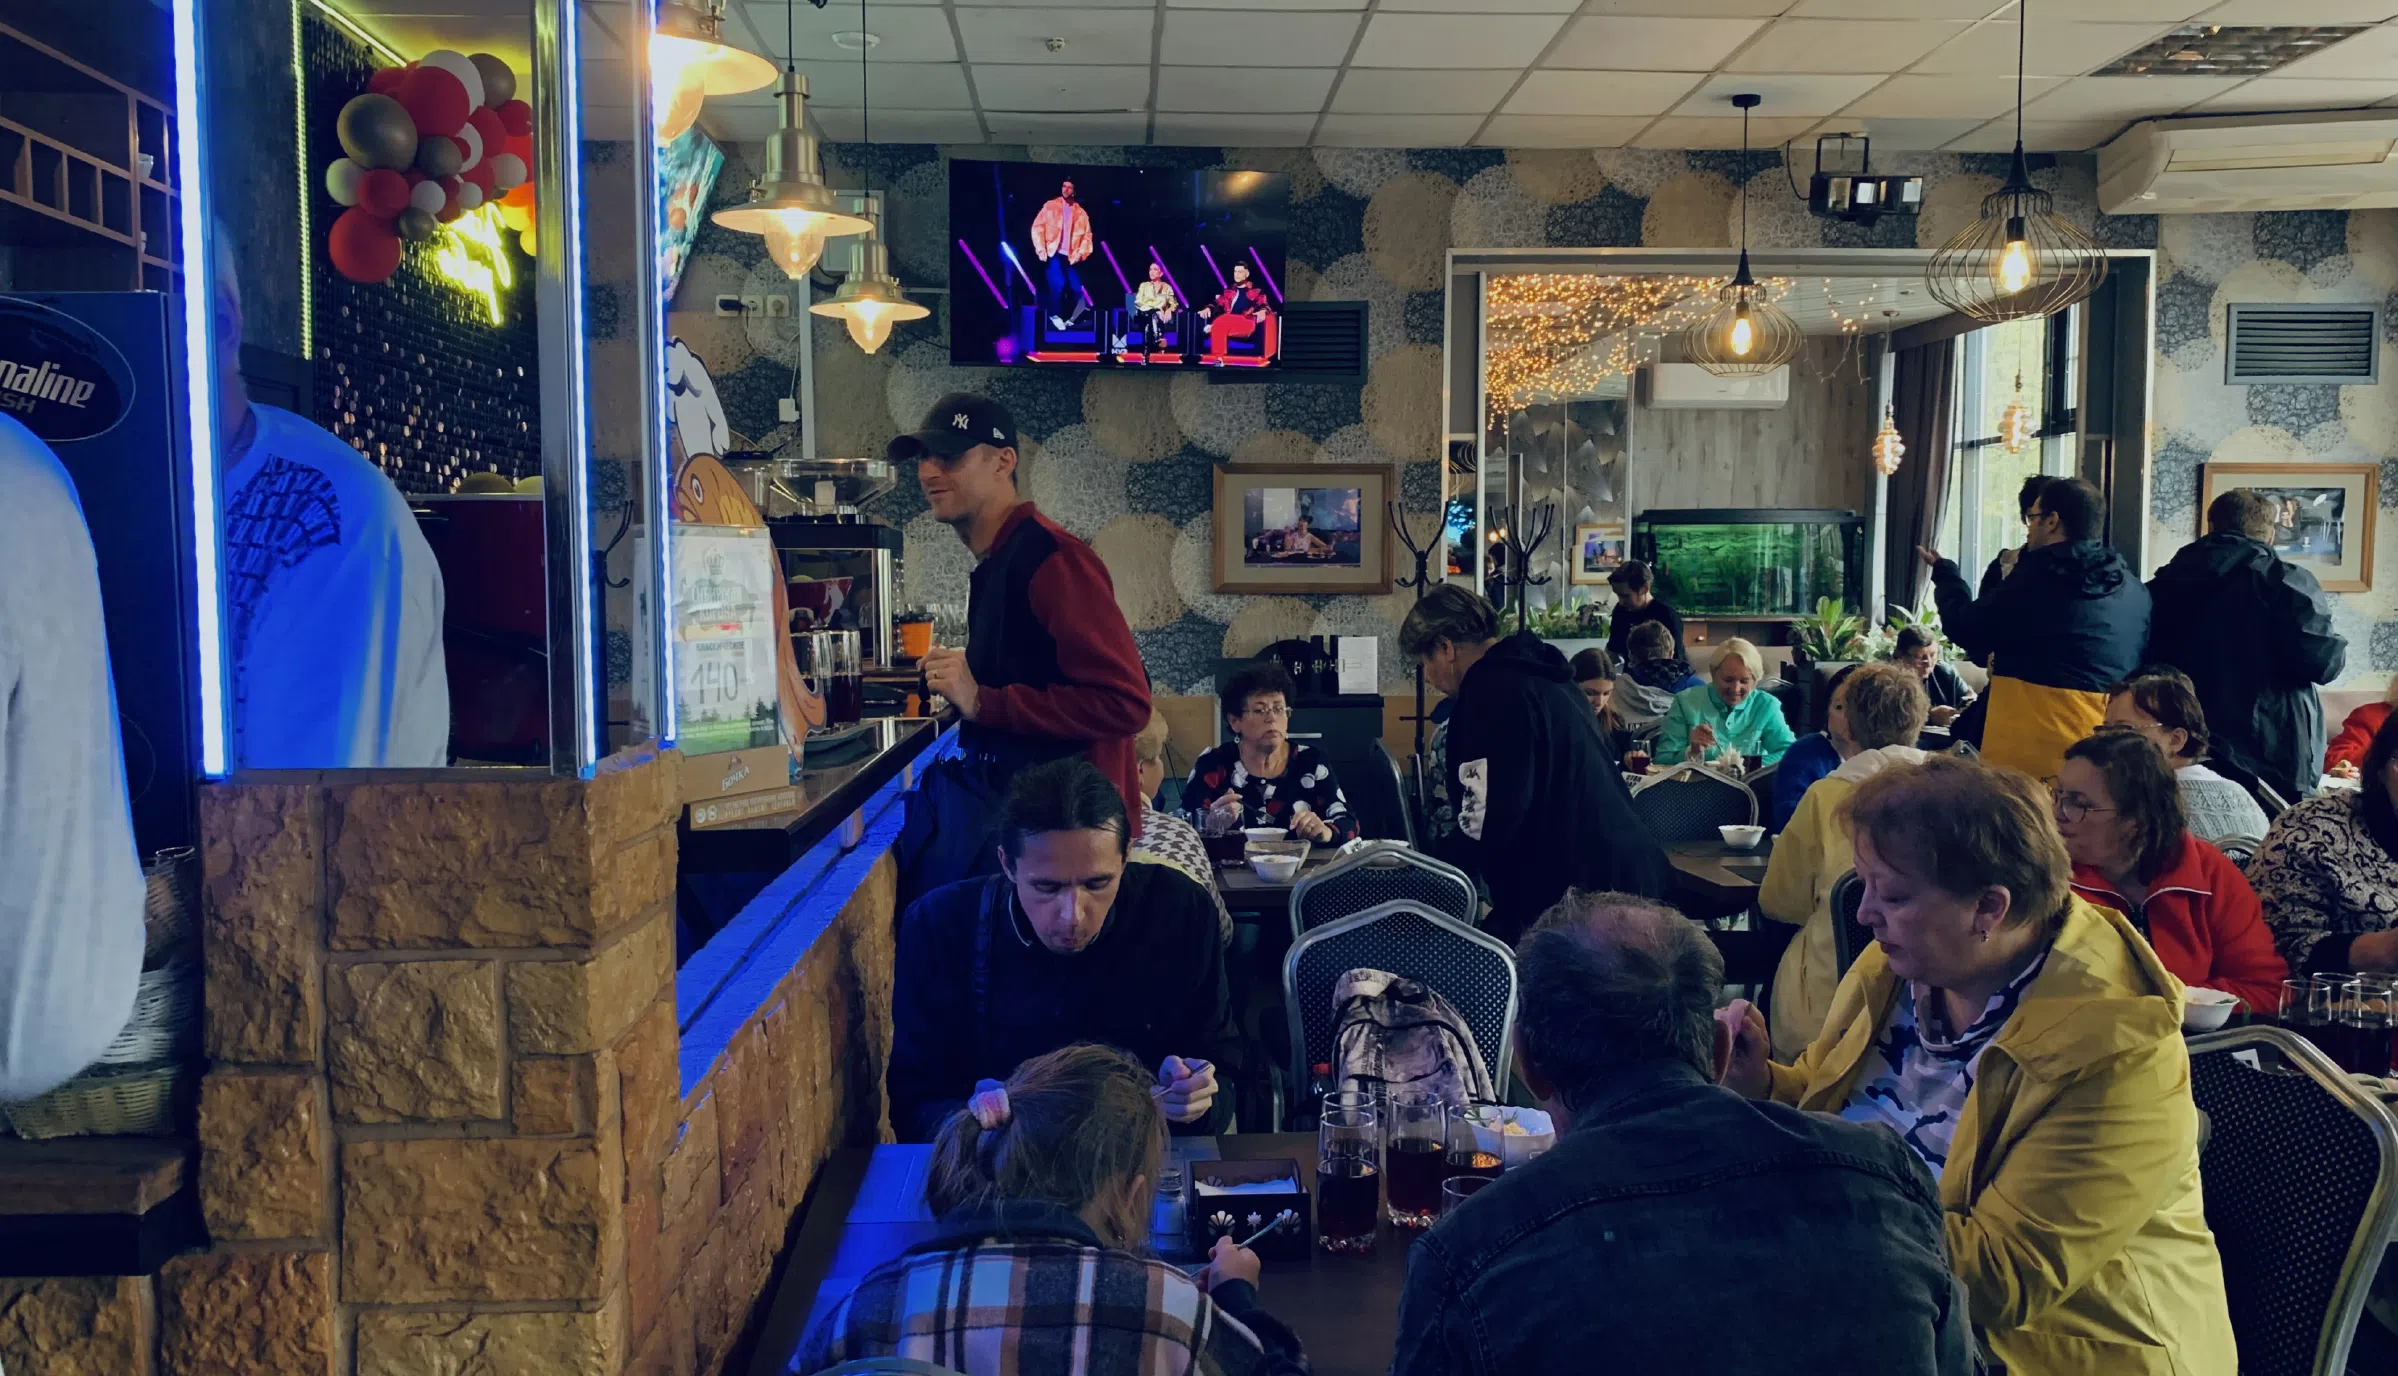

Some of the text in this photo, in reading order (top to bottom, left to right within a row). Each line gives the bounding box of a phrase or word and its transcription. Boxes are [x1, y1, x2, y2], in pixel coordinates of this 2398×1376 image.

[0, 390, 37, 413] SH
[952, 413, 969, 430] NY
[690, 662, 738, 704] 140
